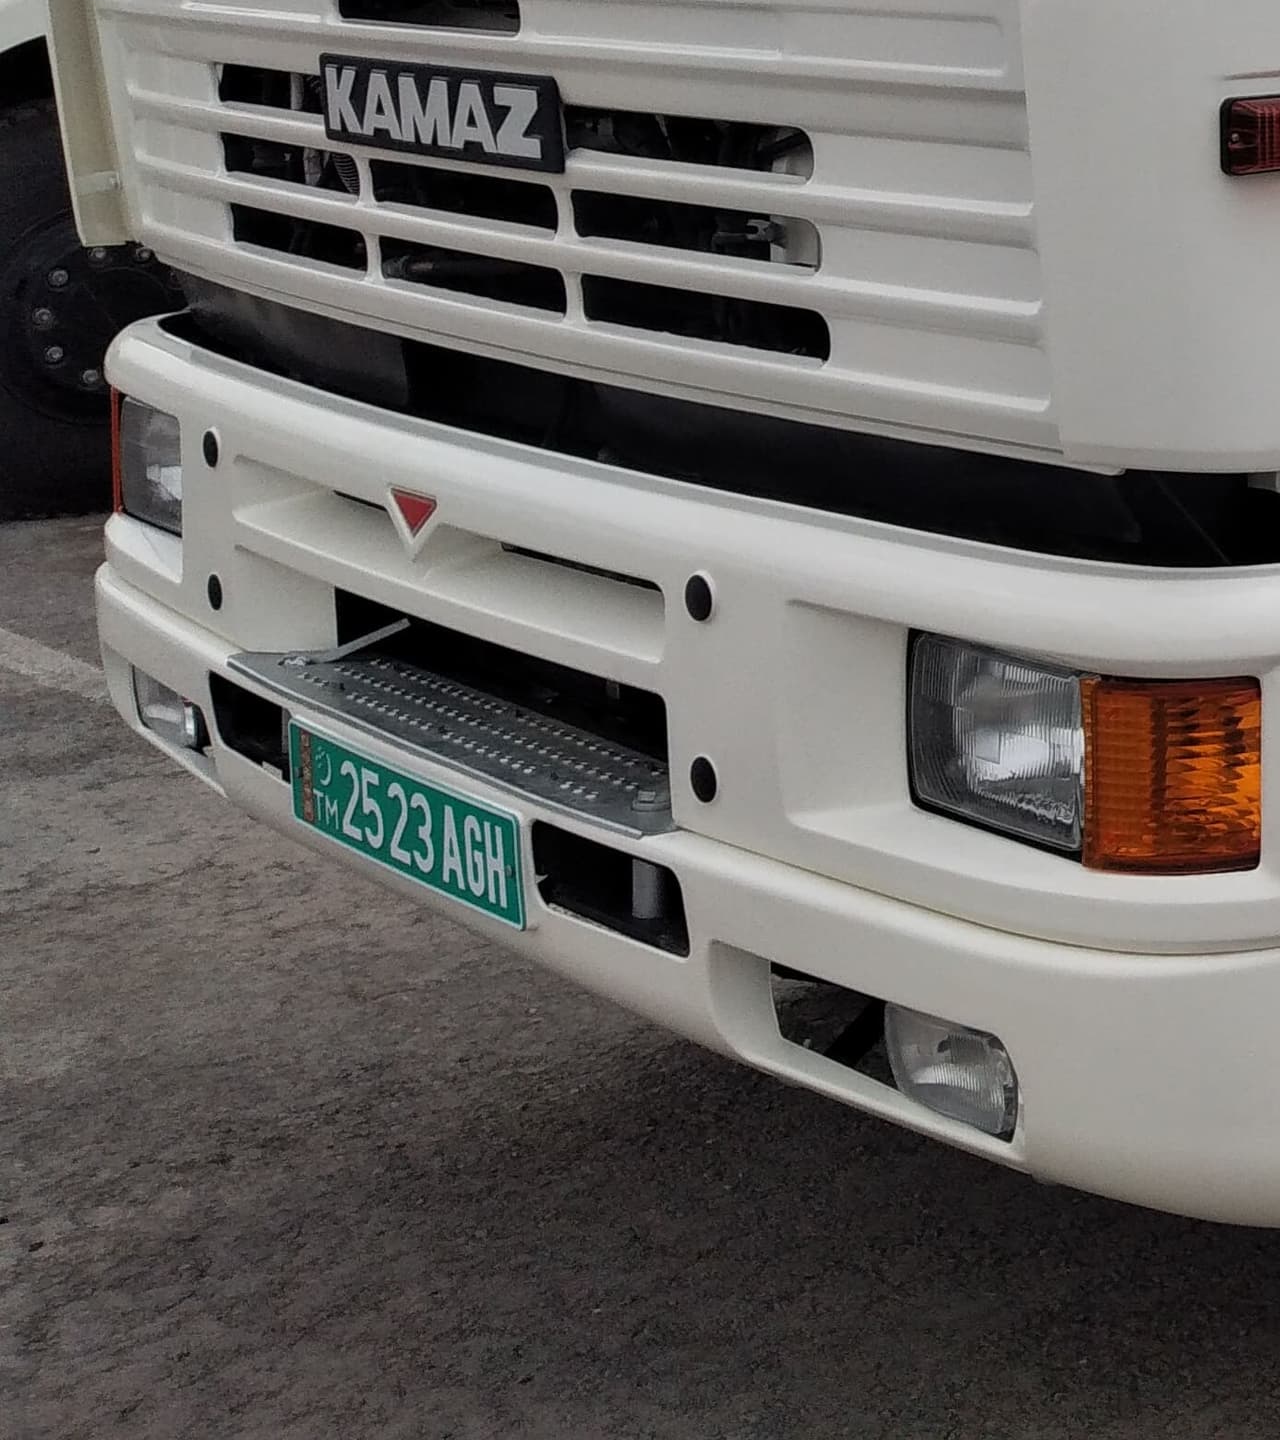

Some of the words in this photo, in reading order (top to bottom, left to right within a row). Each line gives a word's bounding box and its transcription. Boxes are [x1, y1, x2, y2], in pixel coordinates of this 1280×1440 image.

[325, 64, 543, 159] KAMAZ
[313, 787, 339, 830] TM
[340, 760, 435, 873] 2523
[442, 804, 508, 909] AGH
